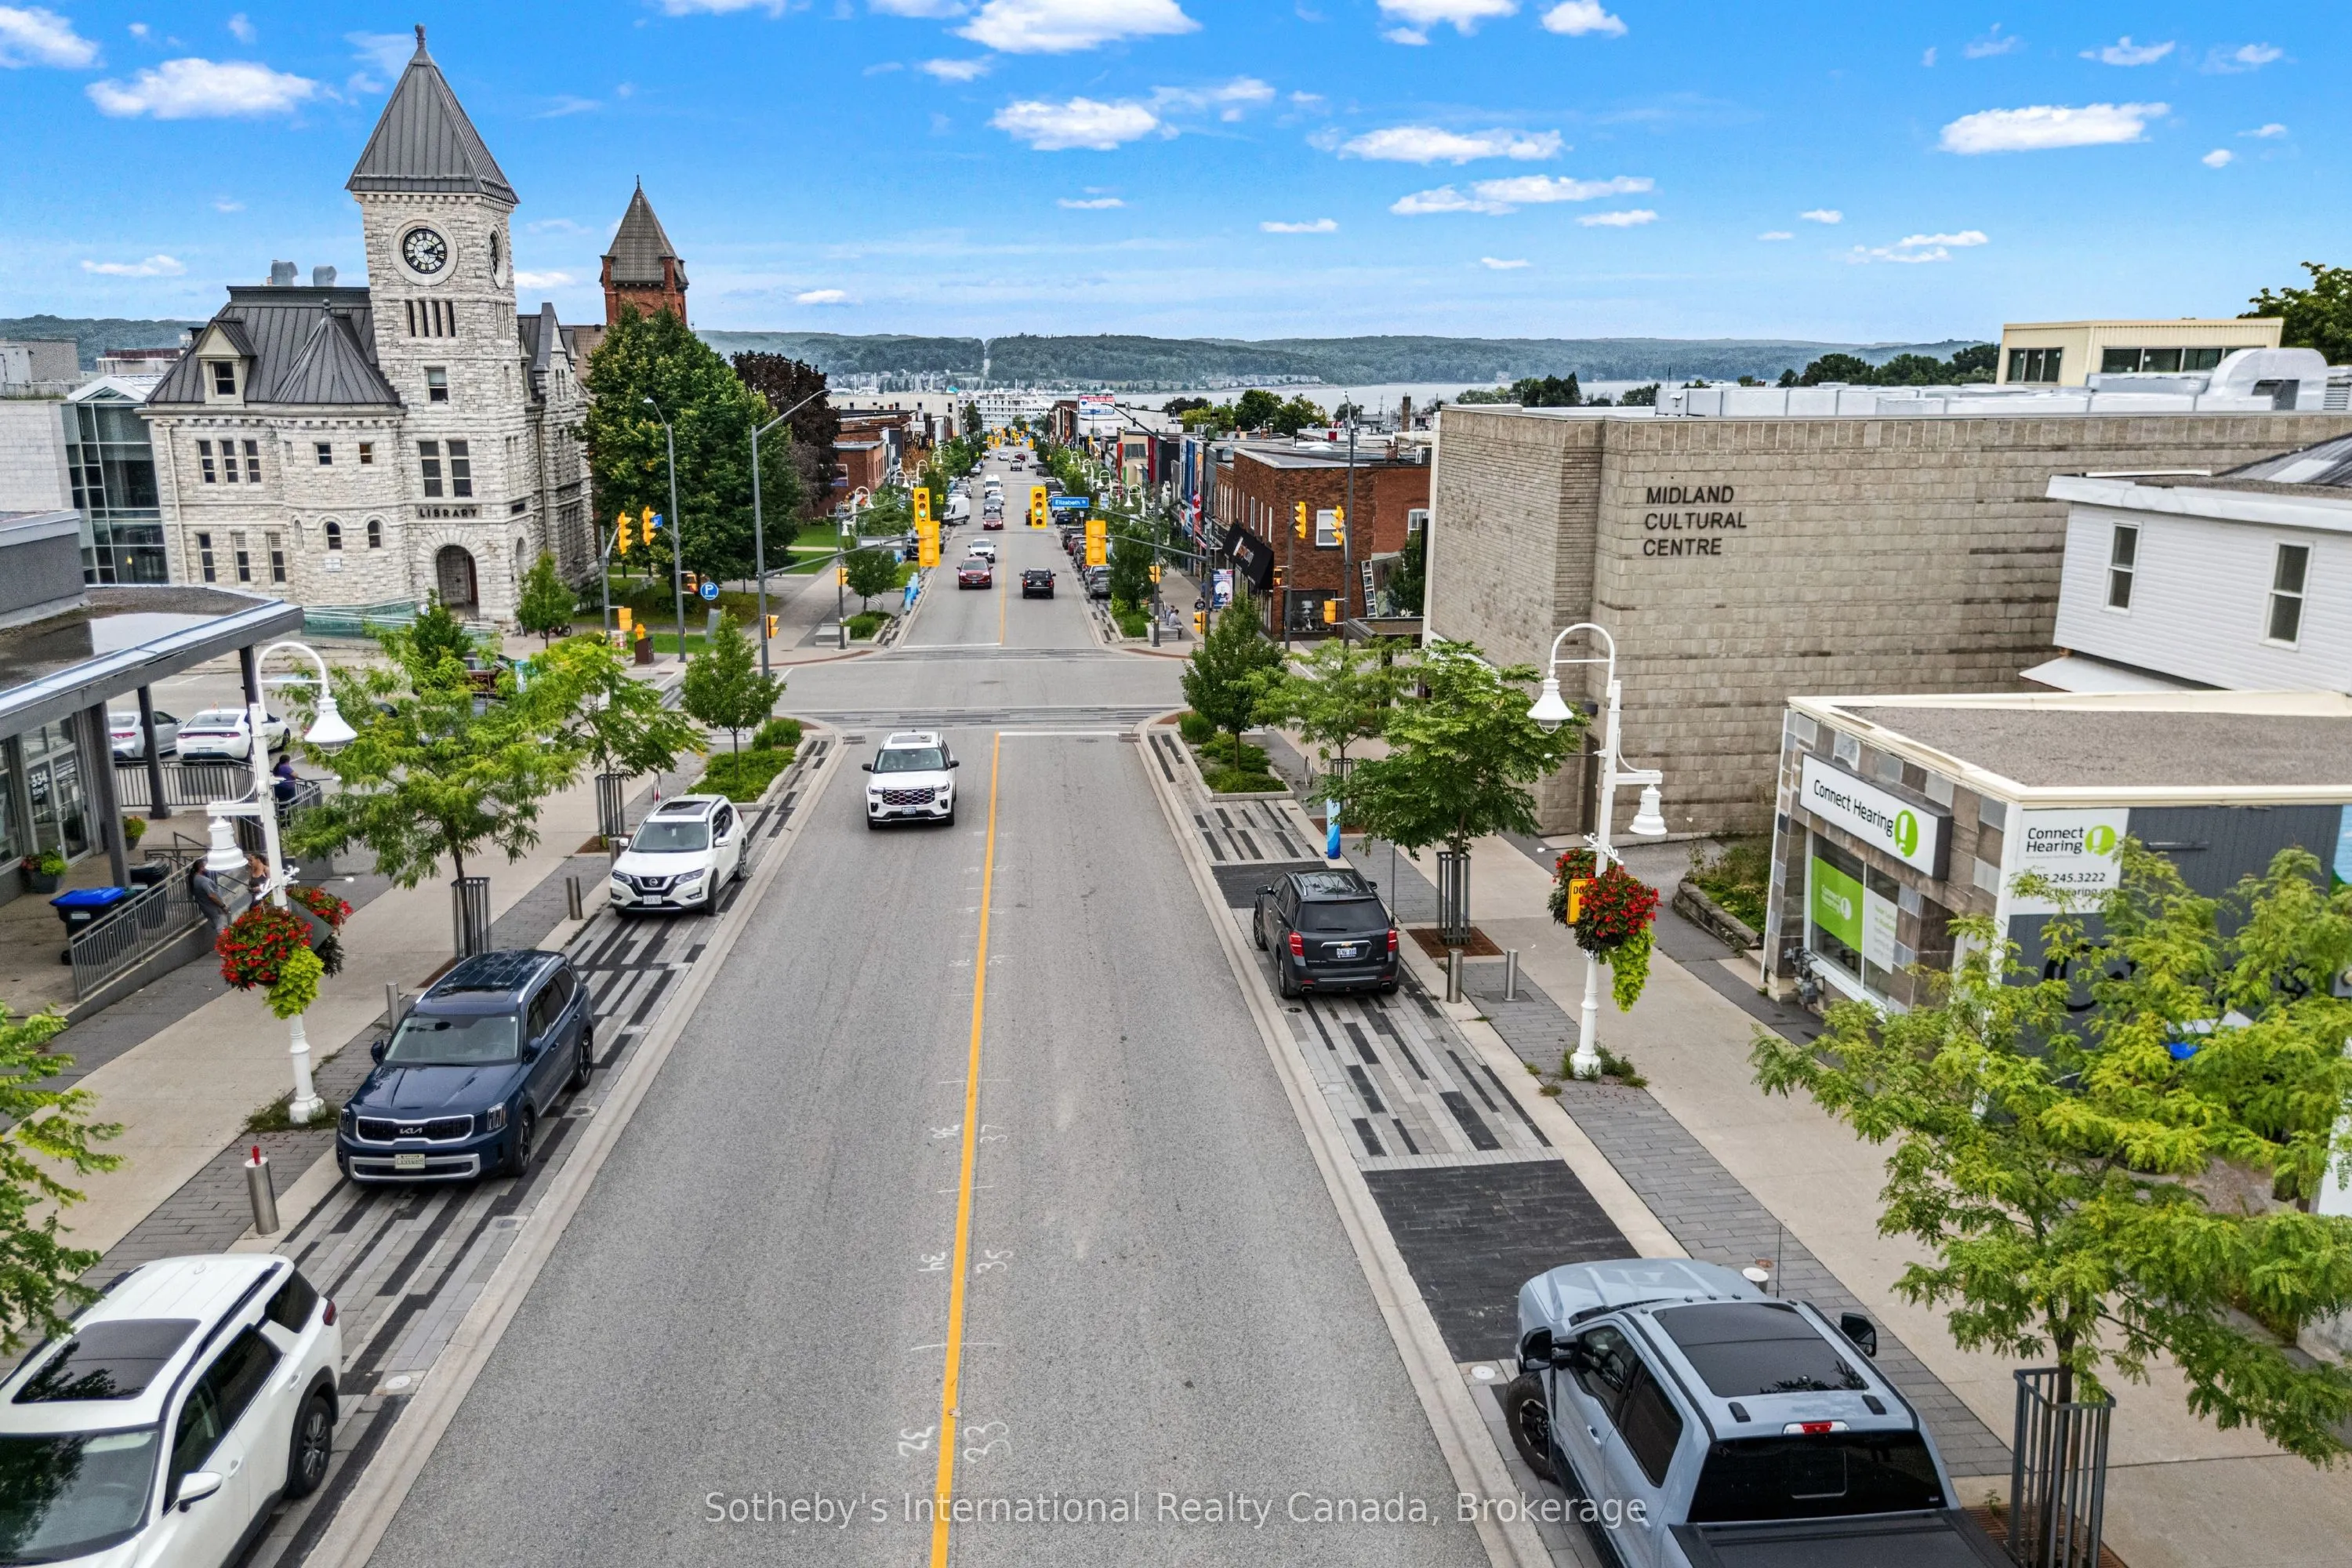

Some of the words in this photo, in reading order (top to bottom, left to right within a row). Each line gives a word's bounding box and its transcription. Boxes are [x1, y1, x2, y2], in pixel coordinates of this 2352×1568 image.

[1646, 485, 1734, 504] MIDLAND
[419, 508, 477, 518] LIBRARY
[1645, 512, 1747, 530] CULTURAL
[1643, 539, 1722, 556] CENTRE
[705, 584, 714, 595] P
[31, 770, 47, 787] 334
[1813, 779, 1851, 812] Connect
[1853, 798, 1894, 837] Hearing
[2027, 826, 2085, 840] Connect
[2026, 840, 2083, 855] Hearing
[979, 1123, 1008, 1143] 37
[917, 1251, 946, 1272] 34
[976, 1249, 1014, 1273] 35
[898, 1425, 936, 1458] 32
[963, 1420, 1012, 1464] 33
